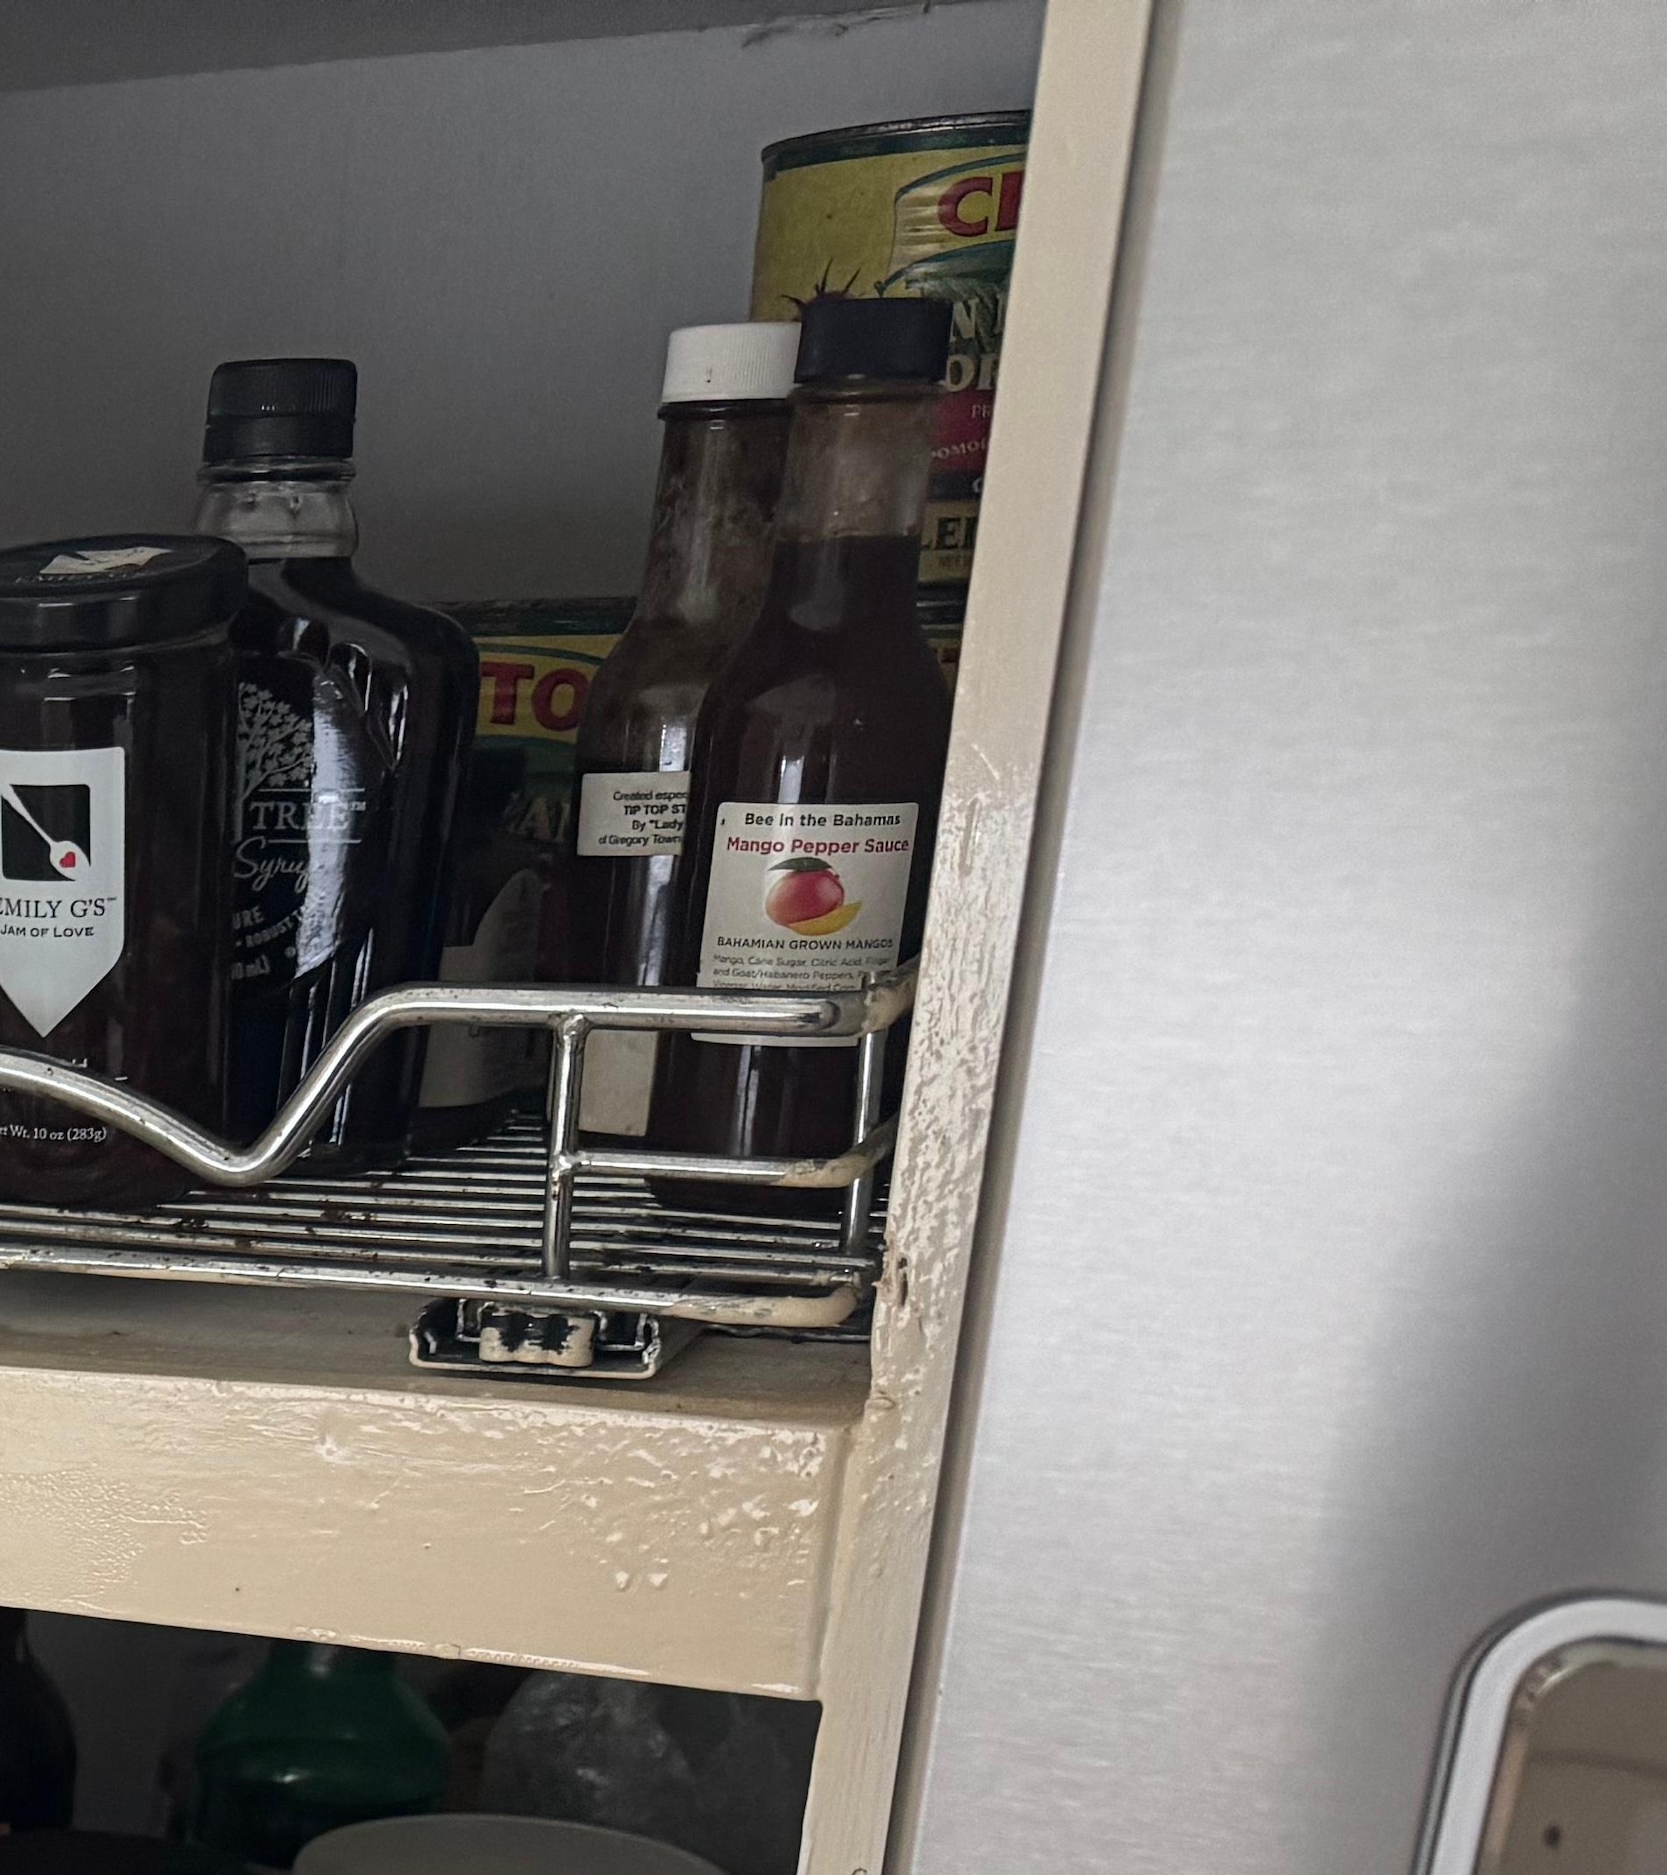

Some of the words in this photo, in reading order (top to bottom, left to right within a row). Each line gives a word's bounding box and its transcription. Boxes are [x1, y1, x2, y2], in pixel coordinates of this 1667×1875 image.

[481, 662, 588, 731] TO
[655, 792, 688, 804] espec
[644, 804, 668, 815] TOP
[671, 804, 686, 814] ST
[745, 813, 773, 826] Bee
[800, 814, 827, 826] the
[833, 814, 901, 826] Bahamas
[726, 837, 785, 854] Mango
[791, 839, 860, 856] Pepper
[864, 838, 909, 853] Sauce
[232, 904, 265, 930] URE
[0, 924, 26, 936] JAM
[30, 927, 49, 938] OF
[53, 925, 95, 938] LOVE
[717, 936, 785, 949] BAHAMIAN
[789, 938, 842, 950] GROWN
[846, 939, 894, 949] MANGOS
[33, 1127, 47, 1140] 10
[49, 1129, 65, 1140] oz
[67, 1127, 107, 1143] (283g)
